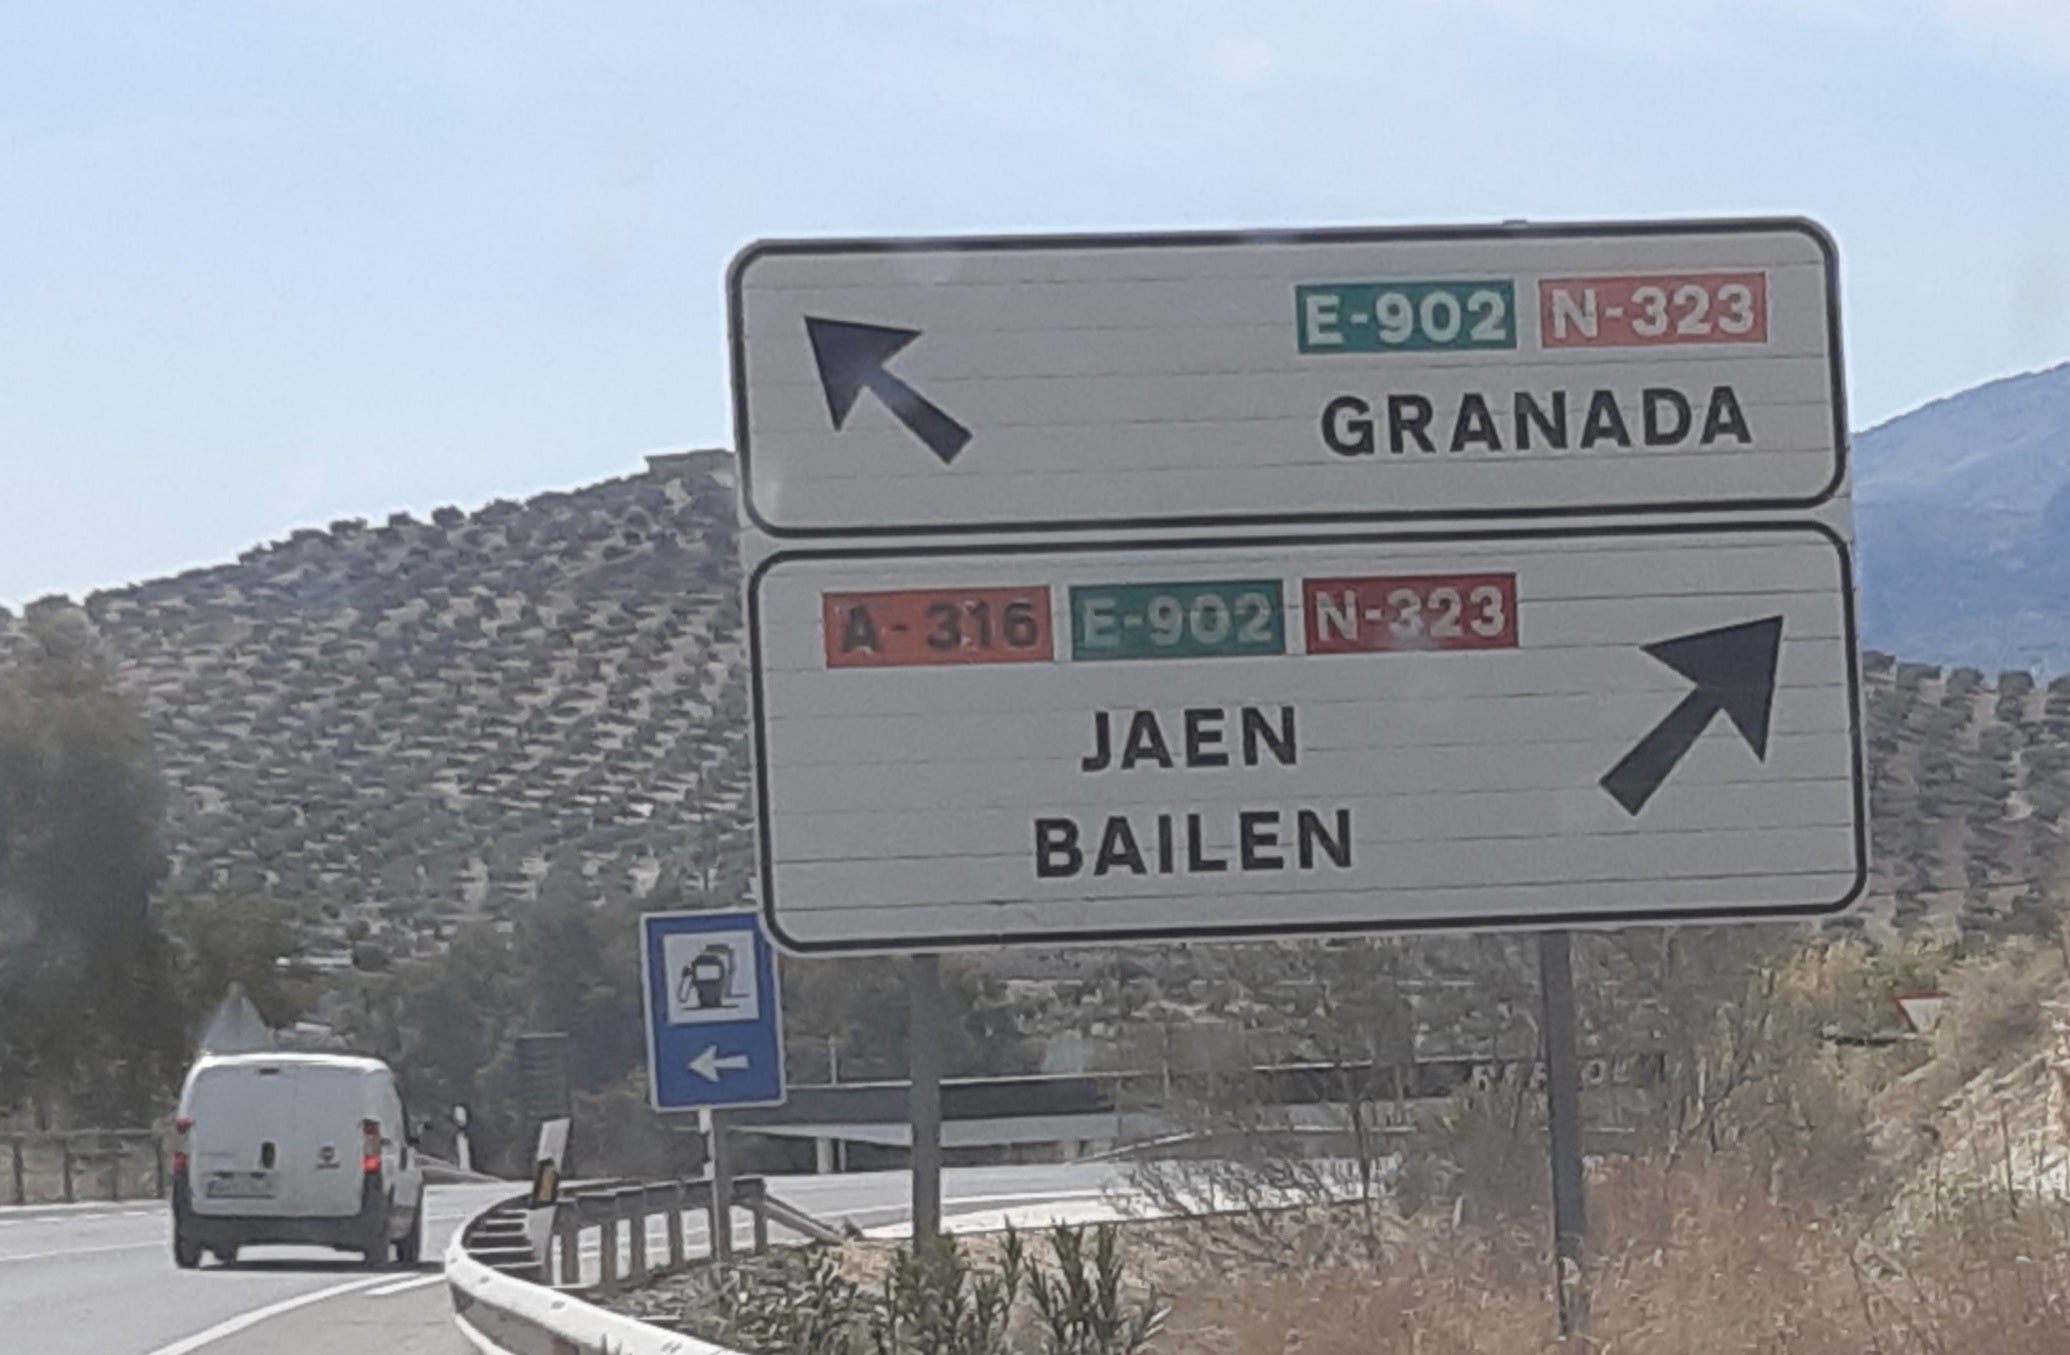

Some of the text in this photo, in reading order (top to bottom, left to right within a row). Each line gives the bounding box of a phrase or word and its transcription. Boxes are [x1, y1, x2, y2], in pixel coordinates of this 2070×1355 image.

[1305, 283, 1756, 346] E-902 N-323
[1321, 385, 1753, 457] GRANADA
[1083, 592, 1273, 648] E-902
[1315, 585, 1505, 643] N-323
[1081, 705, 1298, 773] JAEN
[1034, 808, 1353, 878] BAILEN
